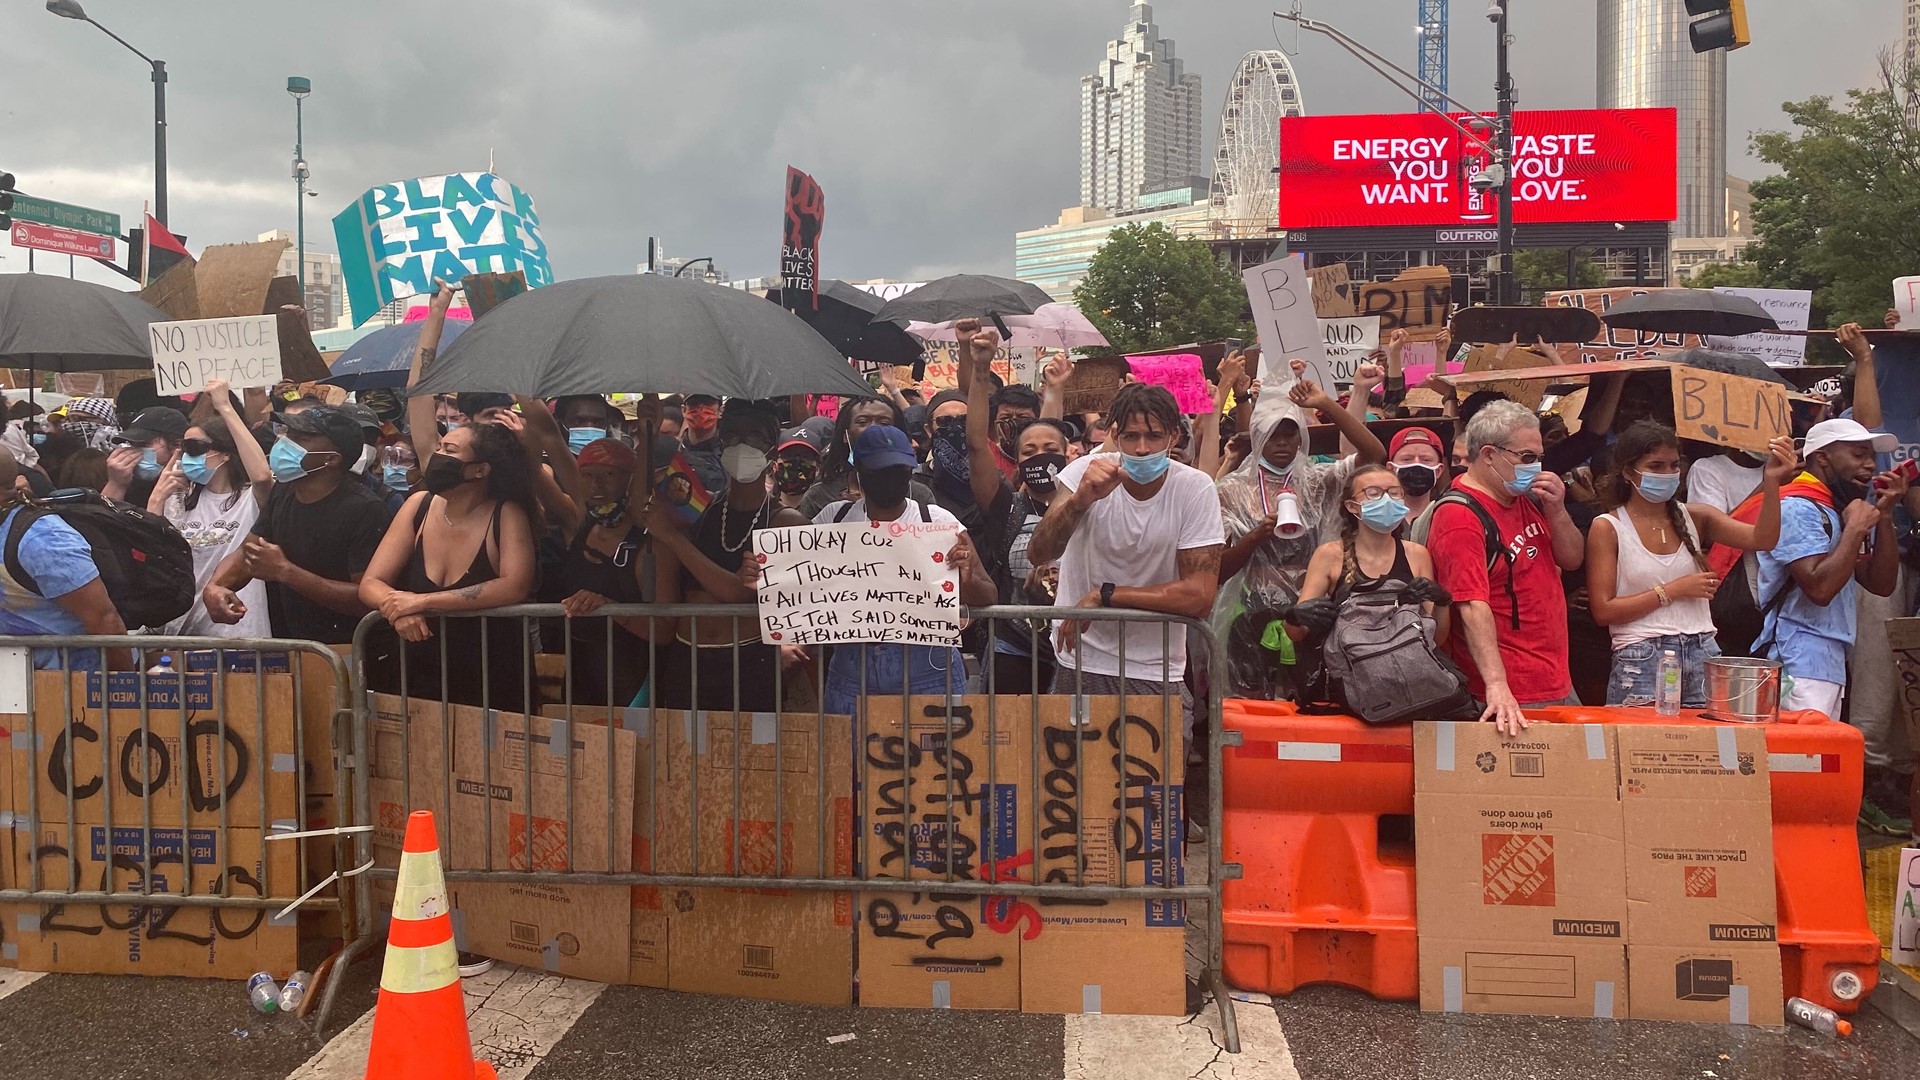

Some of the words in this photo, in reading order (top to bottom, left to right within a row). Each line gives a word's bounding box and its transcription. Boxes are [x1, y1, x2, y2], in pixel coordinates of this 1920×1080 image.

[1332, 137, 1449, 160] ENERGY
[1512, 134, 1595, 156] TASTE
[1388, 160, 1448, 181] YOU
[1511, 157, 1564, 178] YOU
[362, 172, 540, 226] BLACK
[1360, 183, 1449, 204] WANT.
[13, 201, 51, 217] entennial
[53, 206, 83, 224] Olympic
[86, 213, 103, 227] Park
[53, 231, 78, 240] HONORARY
[370, 205, 548, 262] LIVES
[1290, 232, 1306, 241] 506
[1440, 231, 1498, 241] OUTFRON
[30, 235, 64, 248] Dominique
[64, 240, 84, 251] Wilkins
[85, 245, 99, 253] Lane
[782, 245, 815, 263] BLACK
[377, 243, 555, 306] MATTER
[1365, 284, 1450, 330] BLM
[1775, 319, 1798, 327] owers
[151, 323, 187, 352] NO
[191, 320, 271, 352] JUSTICE
[921, 350, 942, 364] BE
[1327, 348, 1349, 357] AND
[157, 358, 192, 391] NO
[199, 355, 277, 385] PEACE
[1153, 368, 1188, 378] LIVES
[1681, 376, 1791, 435] BLM
[759, 529, 791, 554] OH
[799, 528, 847, 553] OKAY
[759, 565, 778, 590] I
[786, 560, 885, 586] THOUGHT
[898, 565, 921, 581] AN
[764, 610, 839, 631] BITCH
[852, 610, 896, 625] SAID
[906, 630, 962, 646] MATTER
[91, 691, 136, 703] MEDIM
[142, 692, 168, 703] DUT
[171, 692, 208, 703] HEAY
[1501, 741, 1551, 750] 1003944764
[206, 734, 214, 799] owes.com/Mov
[461, 782, 509, 799] MEDUM
[1152, 791, 1164, 840] MEUM
[1478, 809, 1506, 819] done.
[1508, 810, 1534, 818] more
[1536, 808, 1553, 820] get
[1490, 820, 1518, 830] doers
[1521, 821, 1543, 830] How
[96, 844, 140, 856] MEDIM
[147, 845, 172, 856] DUT
[176, 846, 212, 858] HEAY
[1482, 831, 1525, 879] DEPOT
[1651, 851, 1674, 860] PROS
[1676, 853, 1693, 861] THE
[1695, 853, 1714, 861] LIKE
[1717, 854, 1739, 862] PACK
[1152, 843, 1164, 877] DUY
[1169, 857, 1178, 886] ESADO
[1483, 834, 1553, 905] HOME
[1518, 869, 1548, 899] THE
[28, 846, 265, 945] 2020
[509, 887, 523, 896] get
[525, 889, 548, 899] more
[1152, 880, 1164, 921] HEAY
[1170, 900, 1179, 921] MEDI
[1041, 915, 1127, 926] Lowes.com/Movin
[1558, 921, 1615, 935] MEDIUM
[1715, 926, 1772, 939] MEDIUM
[505, 941, 544, 954] 100394476
